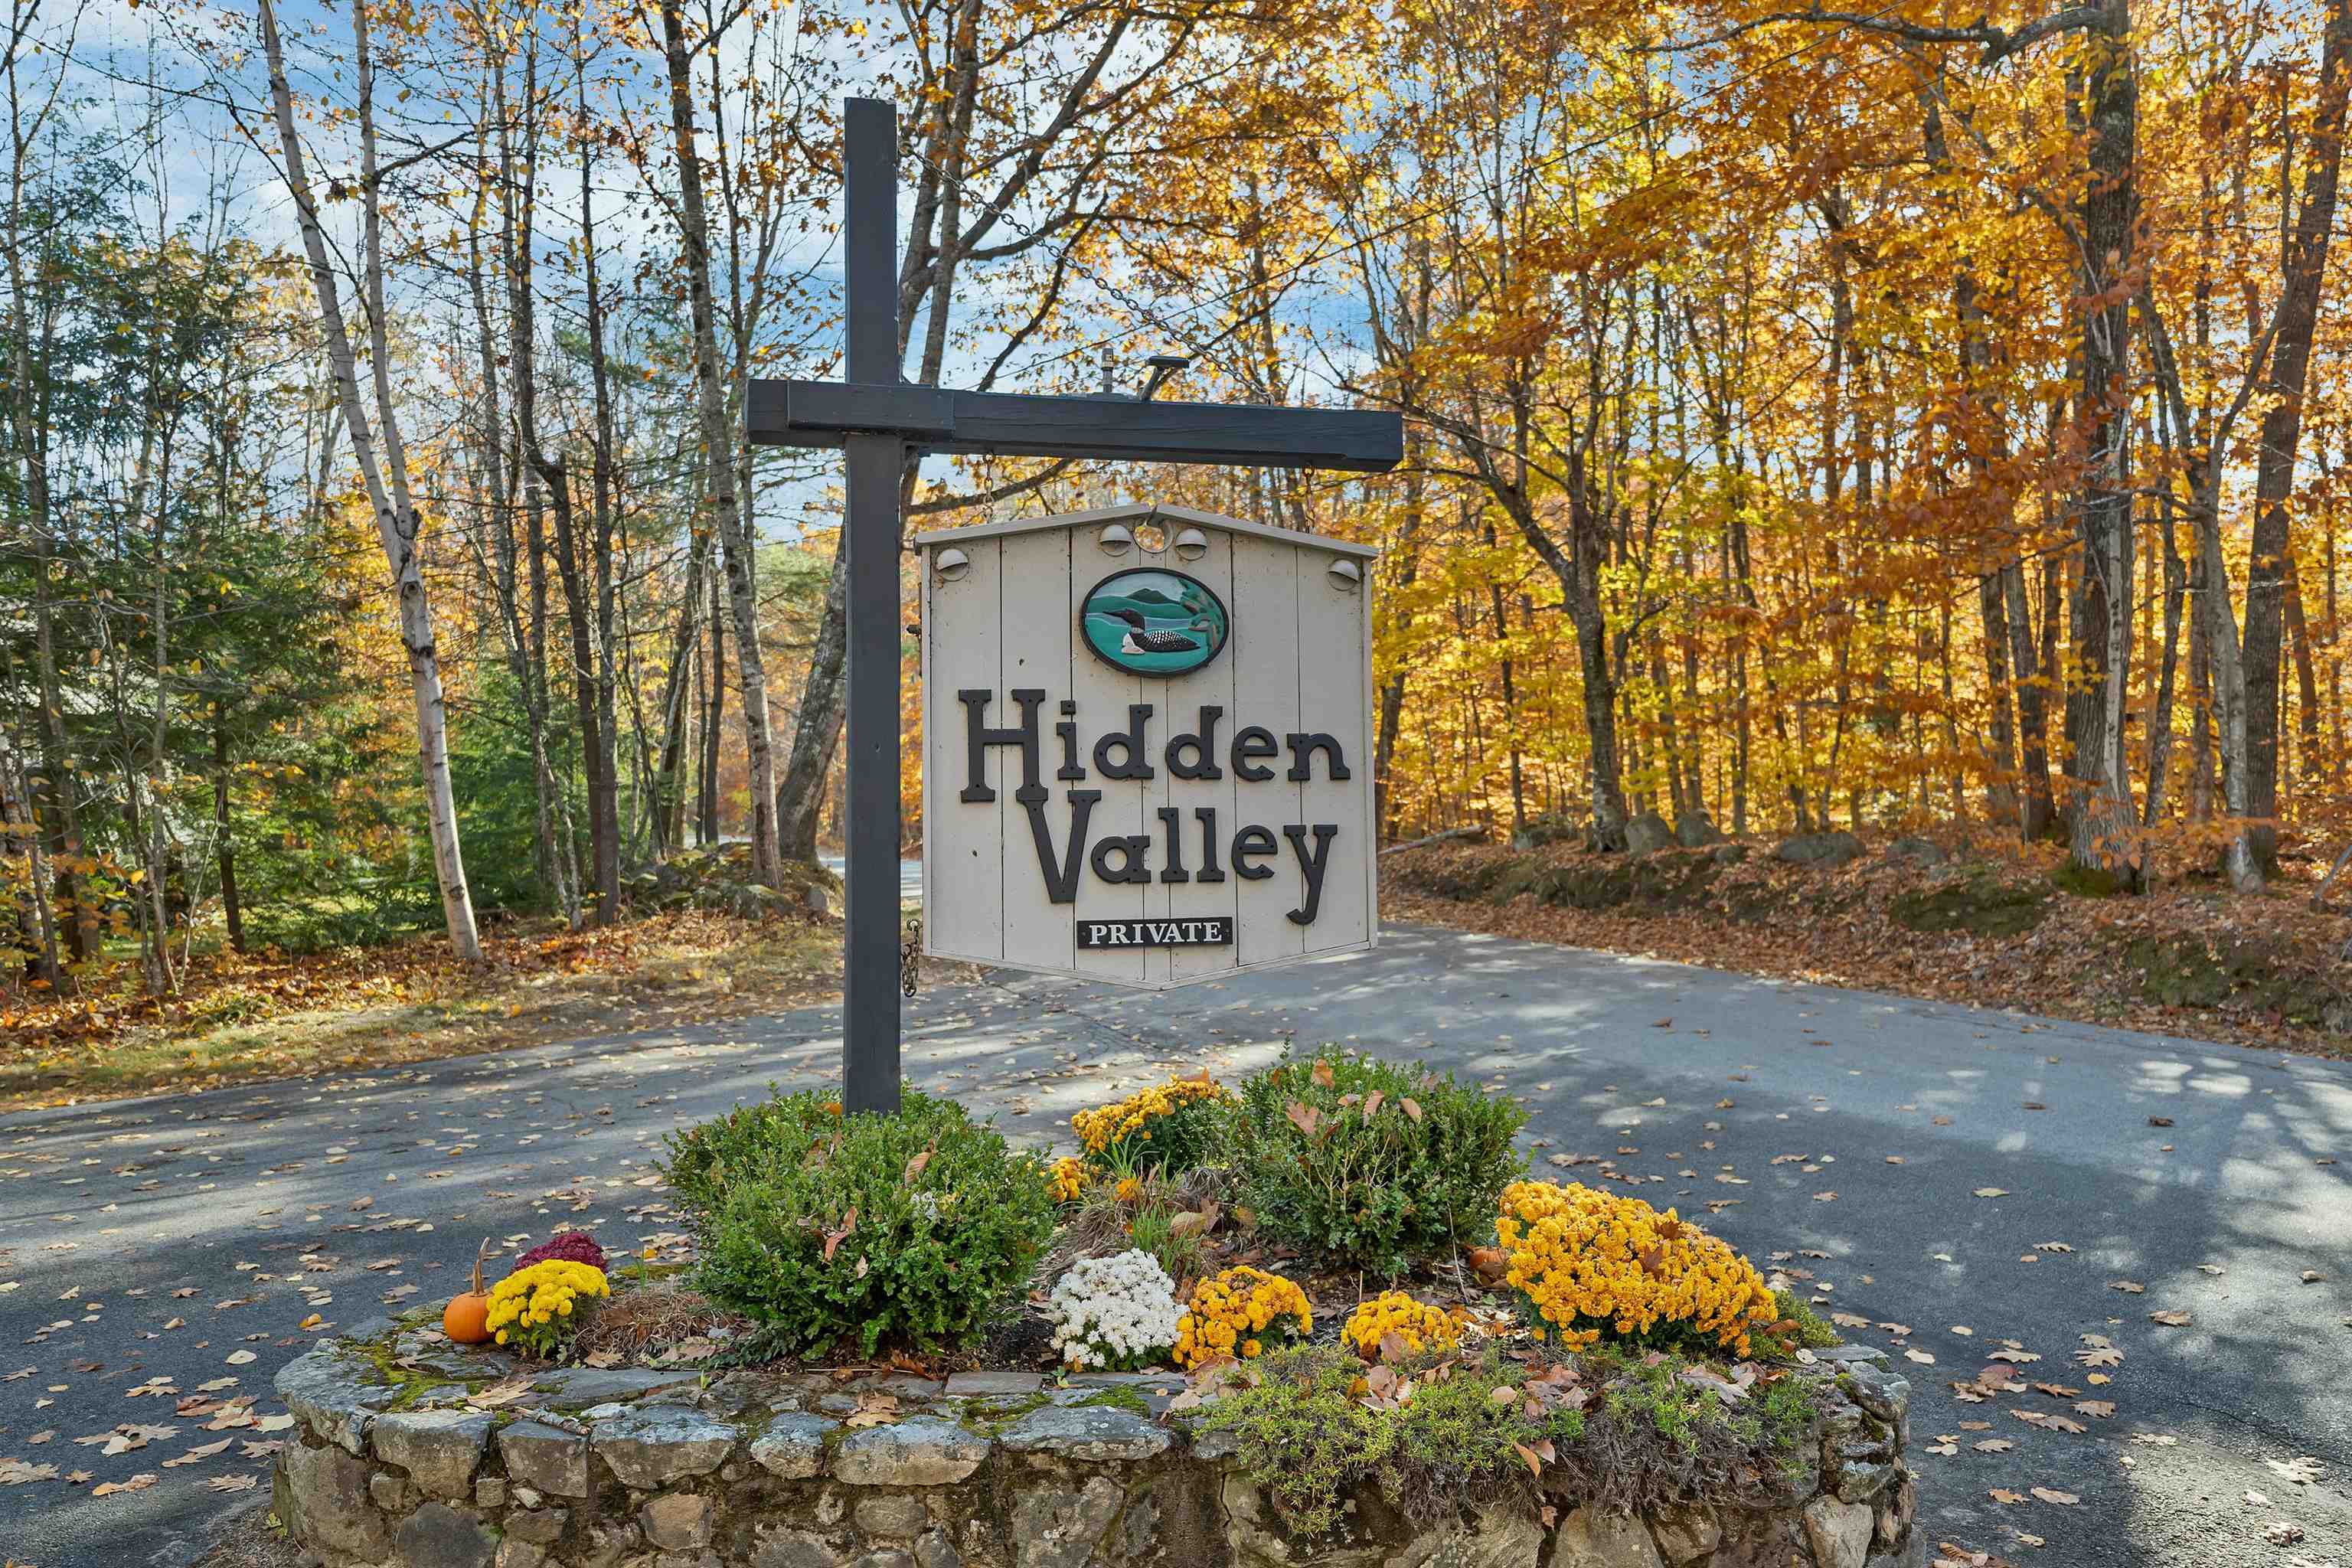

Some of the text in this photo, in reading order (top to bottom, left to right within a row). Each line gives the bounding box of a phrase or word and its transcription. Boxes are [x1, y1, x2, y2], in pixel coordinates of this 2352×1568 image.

[958, 689, 1351, 802] Hidden
[1016, 789, 1338, 925] Valley
[1089, 922, 1223, 945] PRIVATE
